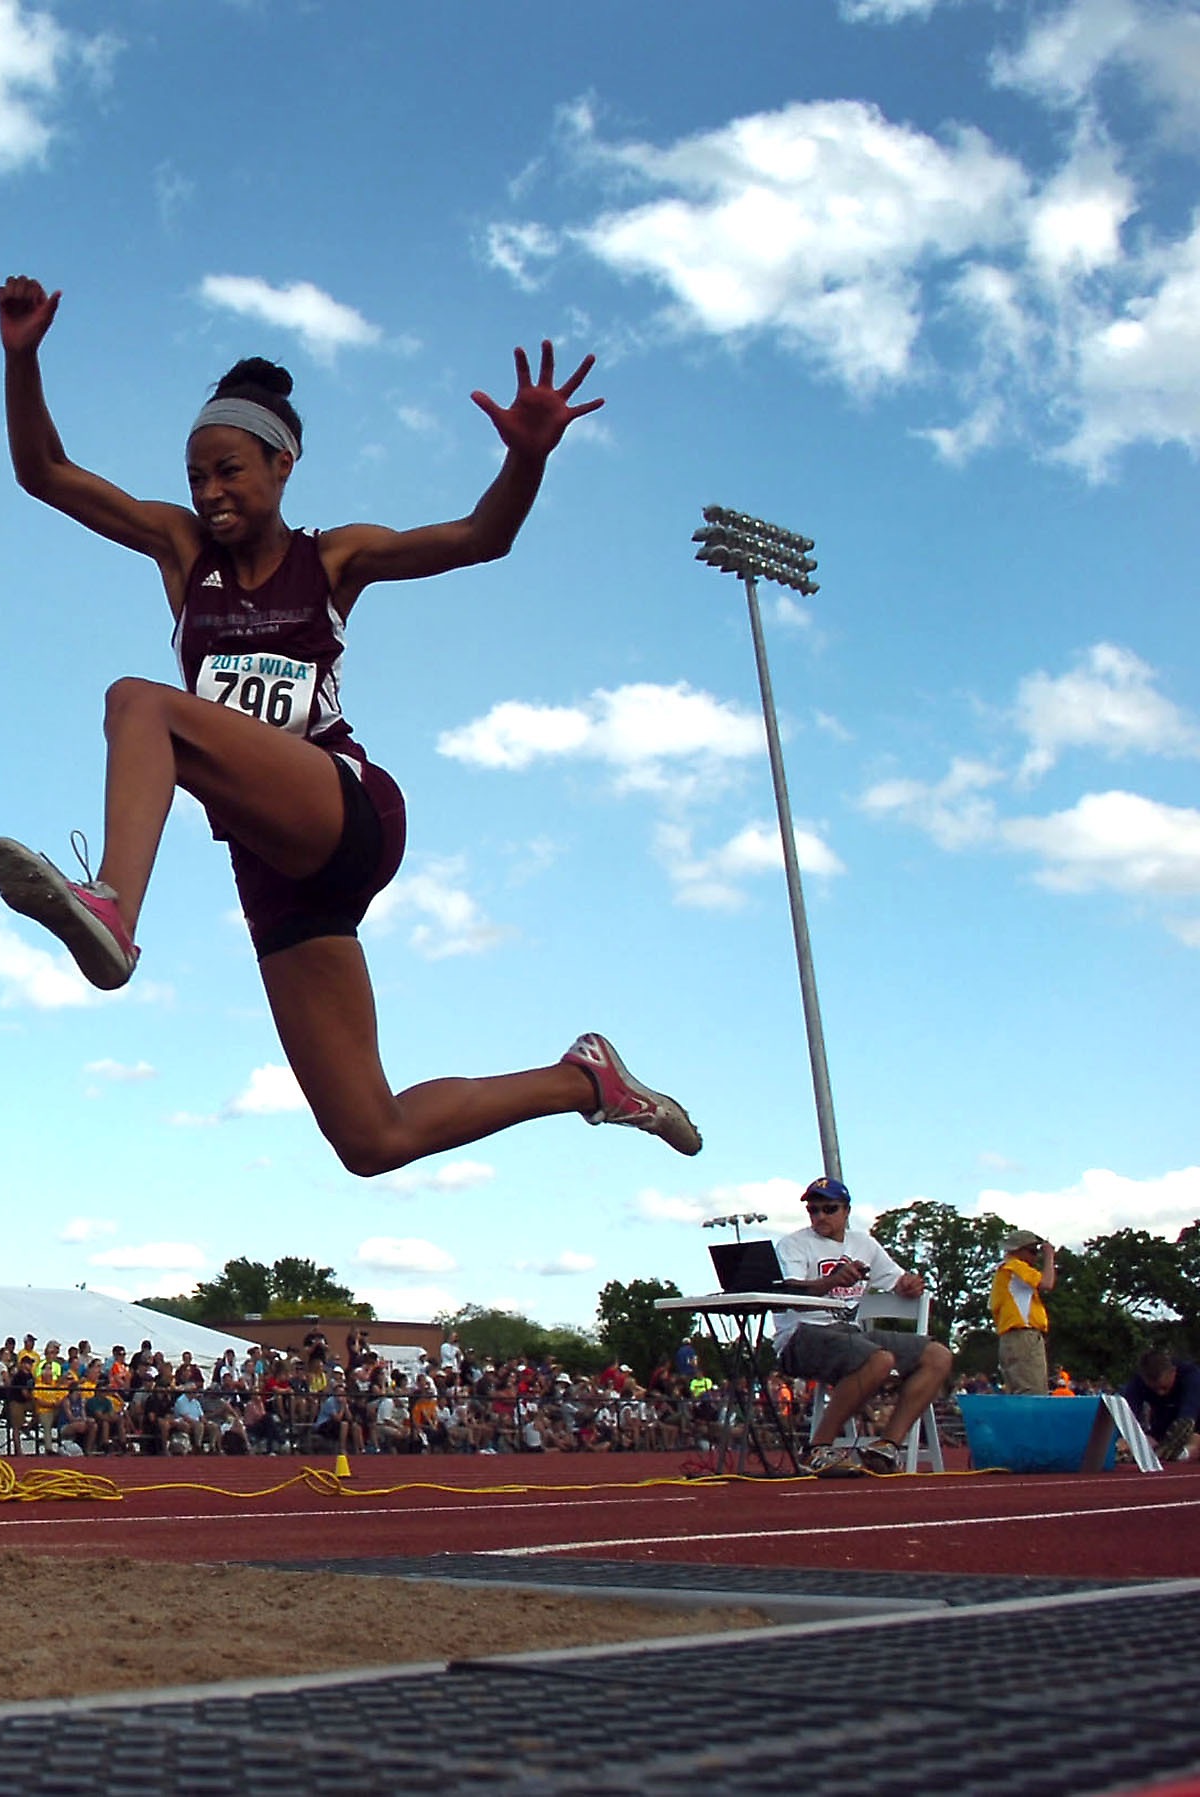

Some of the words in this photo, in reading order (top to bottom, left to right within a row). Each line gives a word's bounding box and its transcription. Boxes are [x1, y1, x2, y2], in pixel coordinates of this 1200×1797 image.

[211, 655, 253, 671] 2013
[259, 658, 307, 680] WIAA
[214, 672, 295, 727] 796
